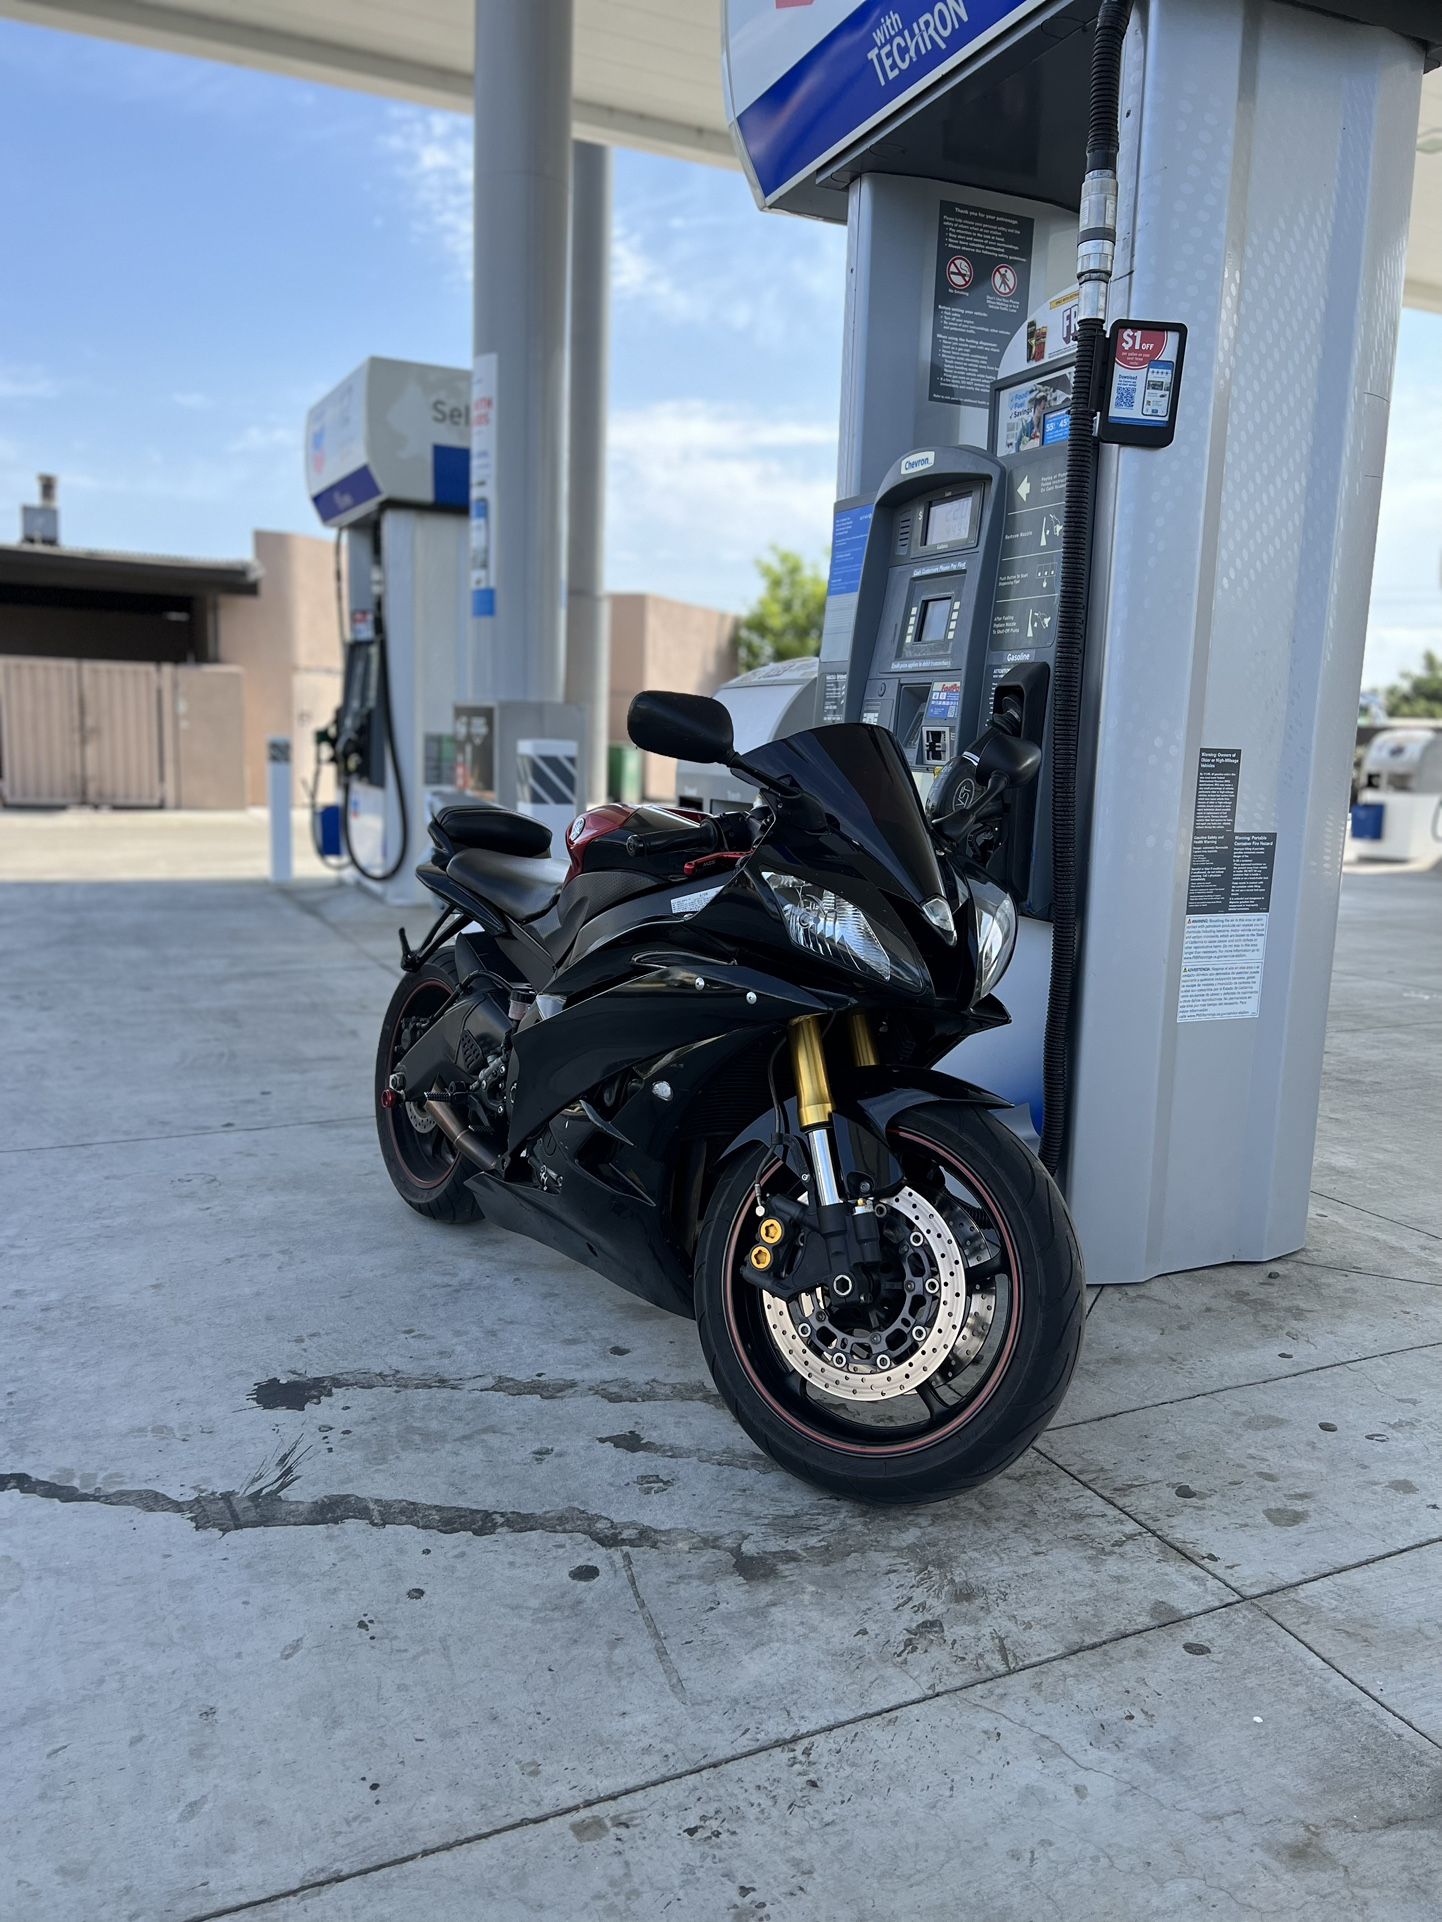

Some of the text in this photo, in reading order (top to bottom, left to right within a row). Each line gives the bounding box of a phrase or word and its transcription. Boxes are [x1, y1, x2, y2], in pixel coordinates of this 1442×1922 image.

[873, 11, 902, 45] with
[868, 0, 969, 86] TECHRON
[1122, 329, 1142, 350] $1
[431, 399, 470, 427] Sel
[1014, 408, 1033, 419] Savings
[905, 458, 929, 470] Chevron
[918, 511, 923, 520] $
[1007, 652, 1030, 661] Gasoline
[955, 785, 971, 808] VST
